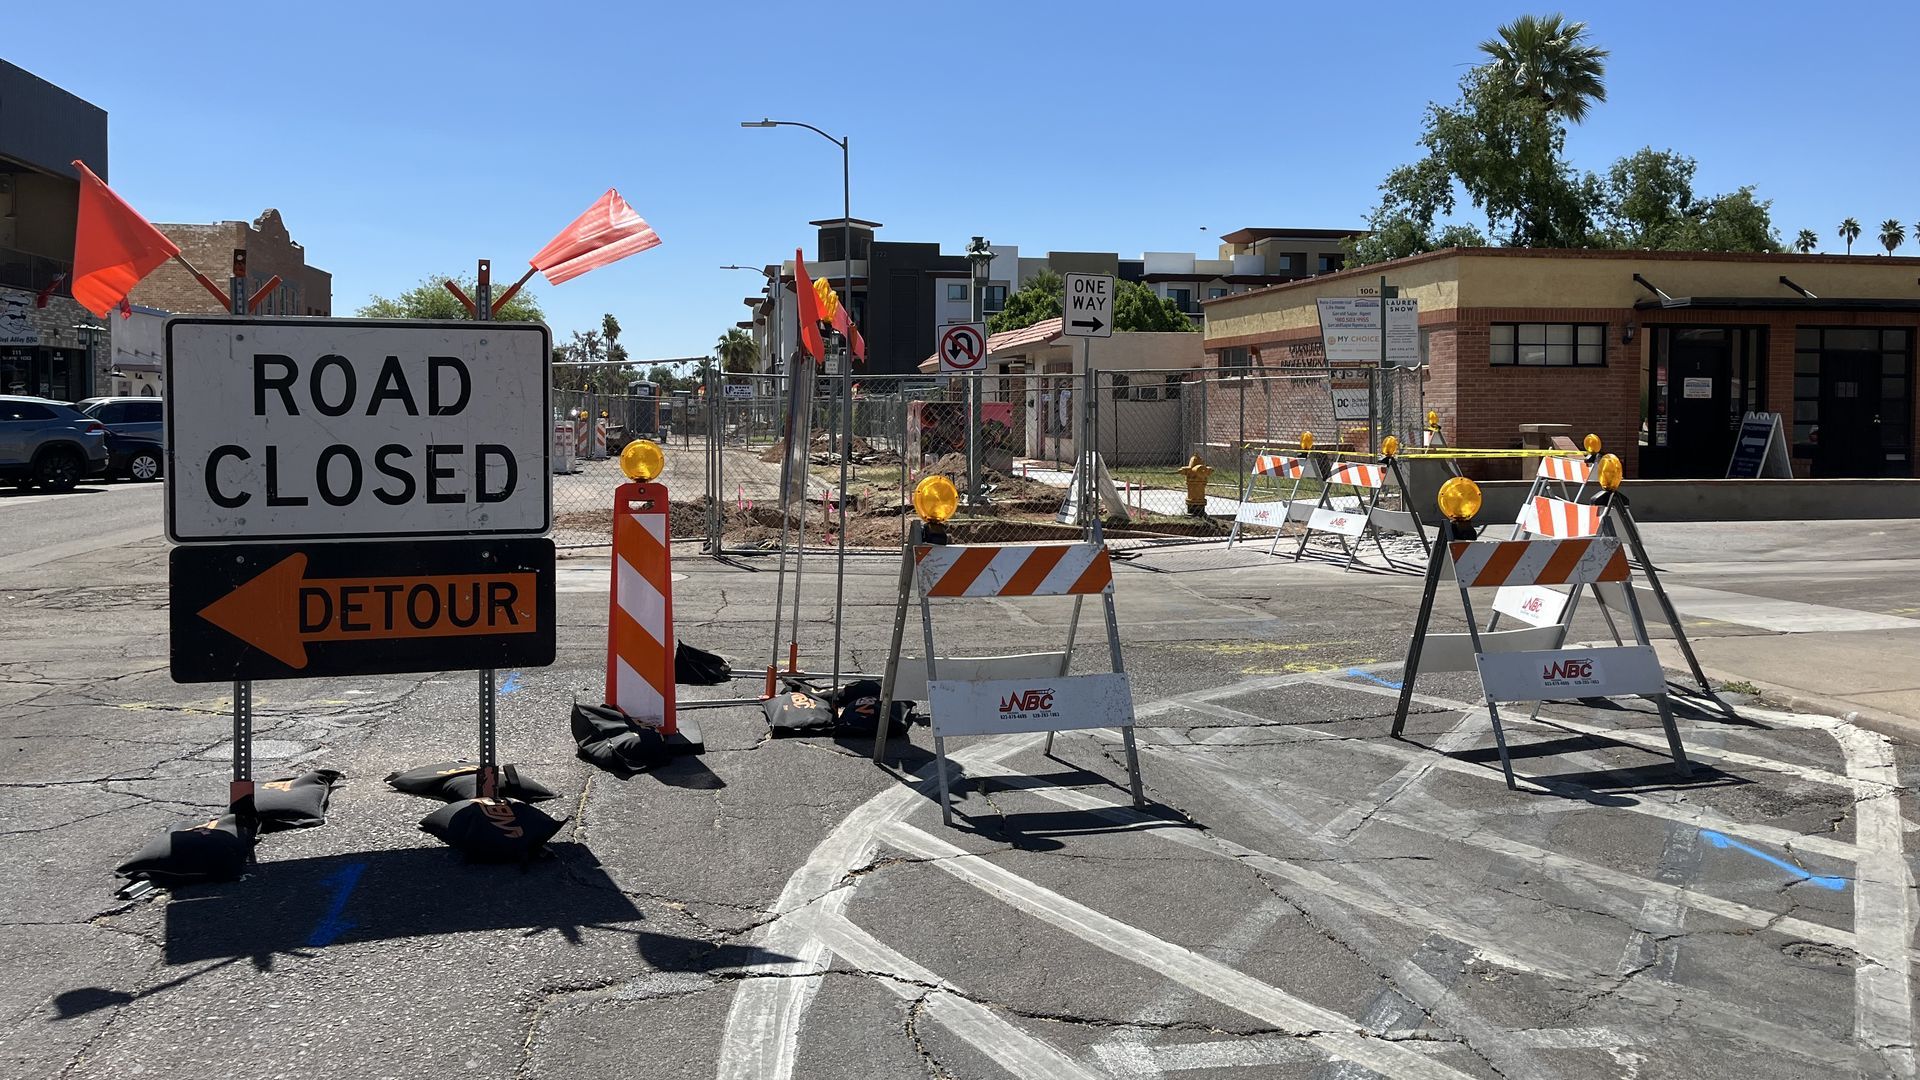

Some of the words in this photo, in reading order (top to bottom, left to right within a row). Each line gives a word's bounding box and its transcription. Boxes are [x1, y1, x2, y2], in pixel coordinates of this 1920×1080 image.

[1075, 279, 1105, 294] ONE
[1073, 296, 1106, 310] WAY
[26, 335, 38, 344] BBQ
[1337, 335, 1349, 343] MY
[1350, 335, 1380, 343] CHOICE
[253, 354, 471, 416] ROAD
[1337, 398, 1349, 408] DC
[205, 444, 518, 508] CLOSED
[299, 581, 519, 633] DETOUR
[1522, 597, 1544, 612] NBC
[1543, 659, 1593, 679] NBC
[999, 689, 1055, 712] NBC
